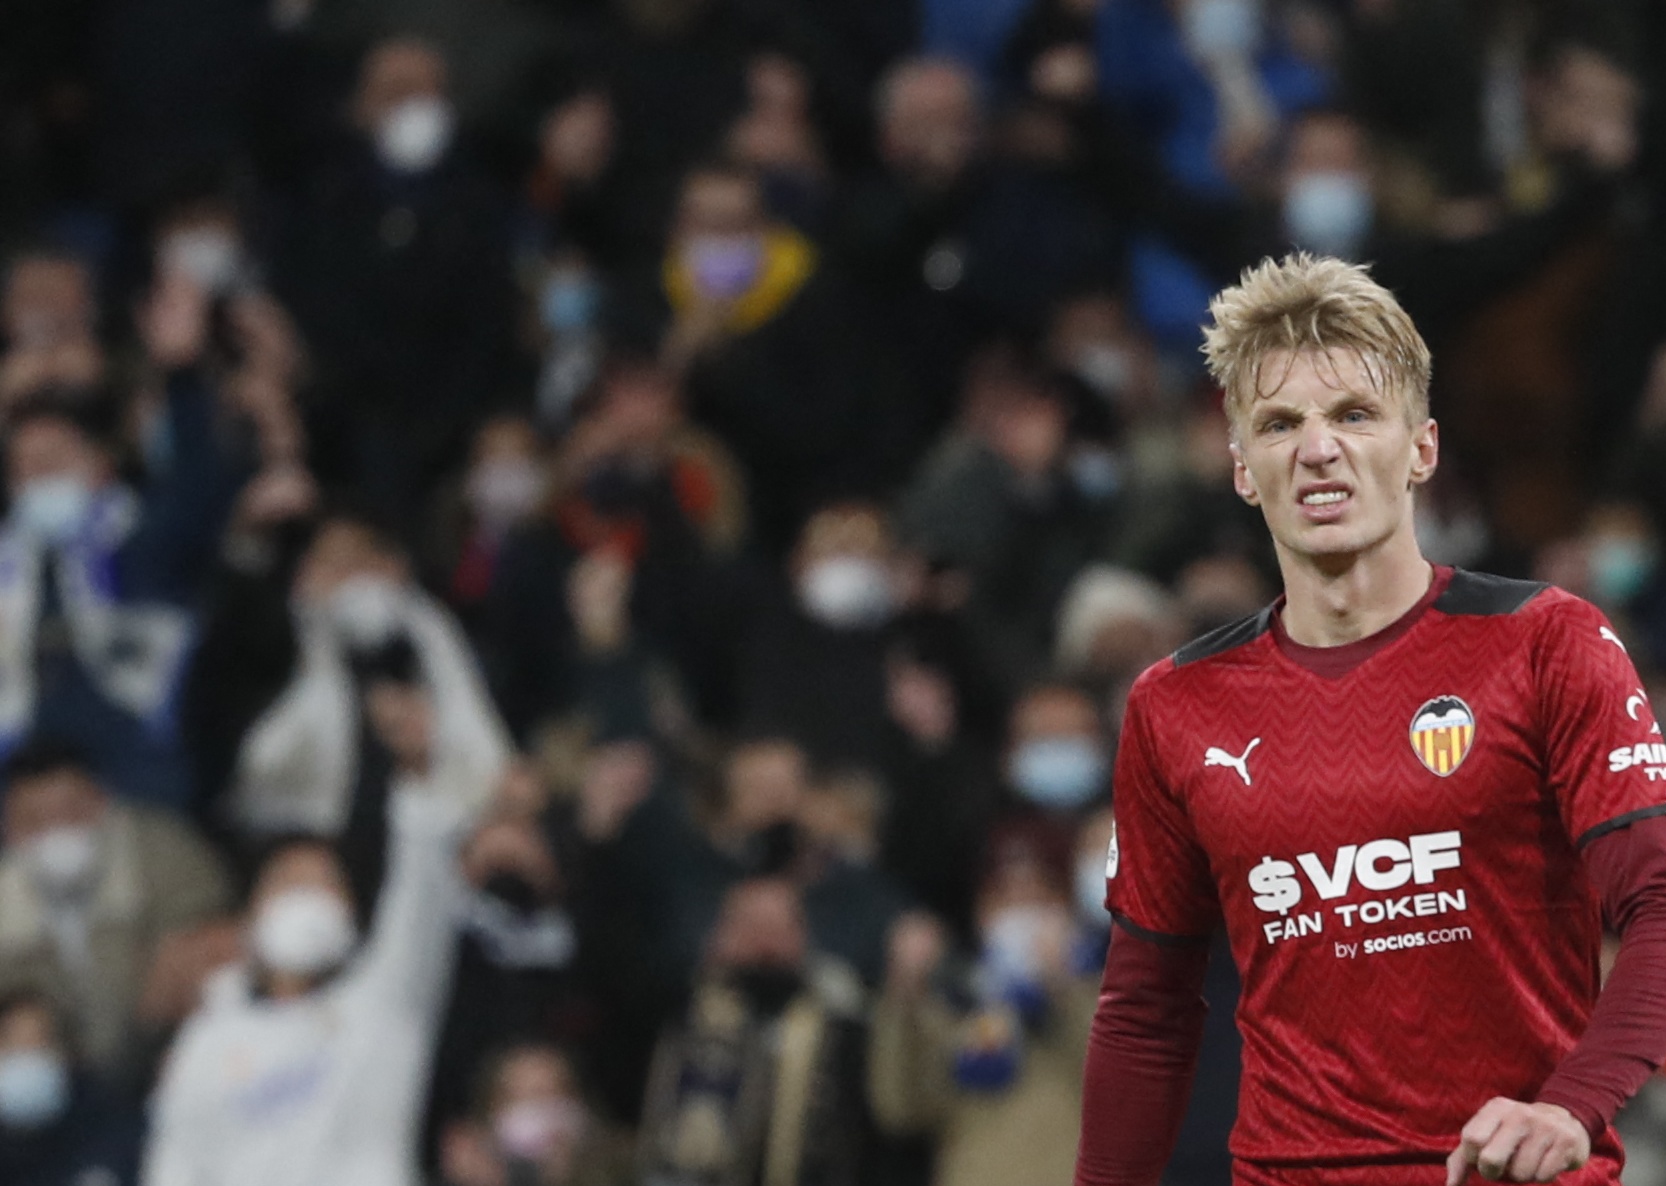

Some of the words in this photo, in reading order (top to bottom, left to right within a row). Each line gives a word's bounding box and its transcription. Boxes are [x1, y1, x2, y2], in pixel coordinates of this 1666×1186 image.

[1248, 831, 1461, 915] $VCF
[1263, 911, 1323, 944] FAN
[1334, 889, 1467, 927] TOKEN
[1334, 941, 1358, 959] by
